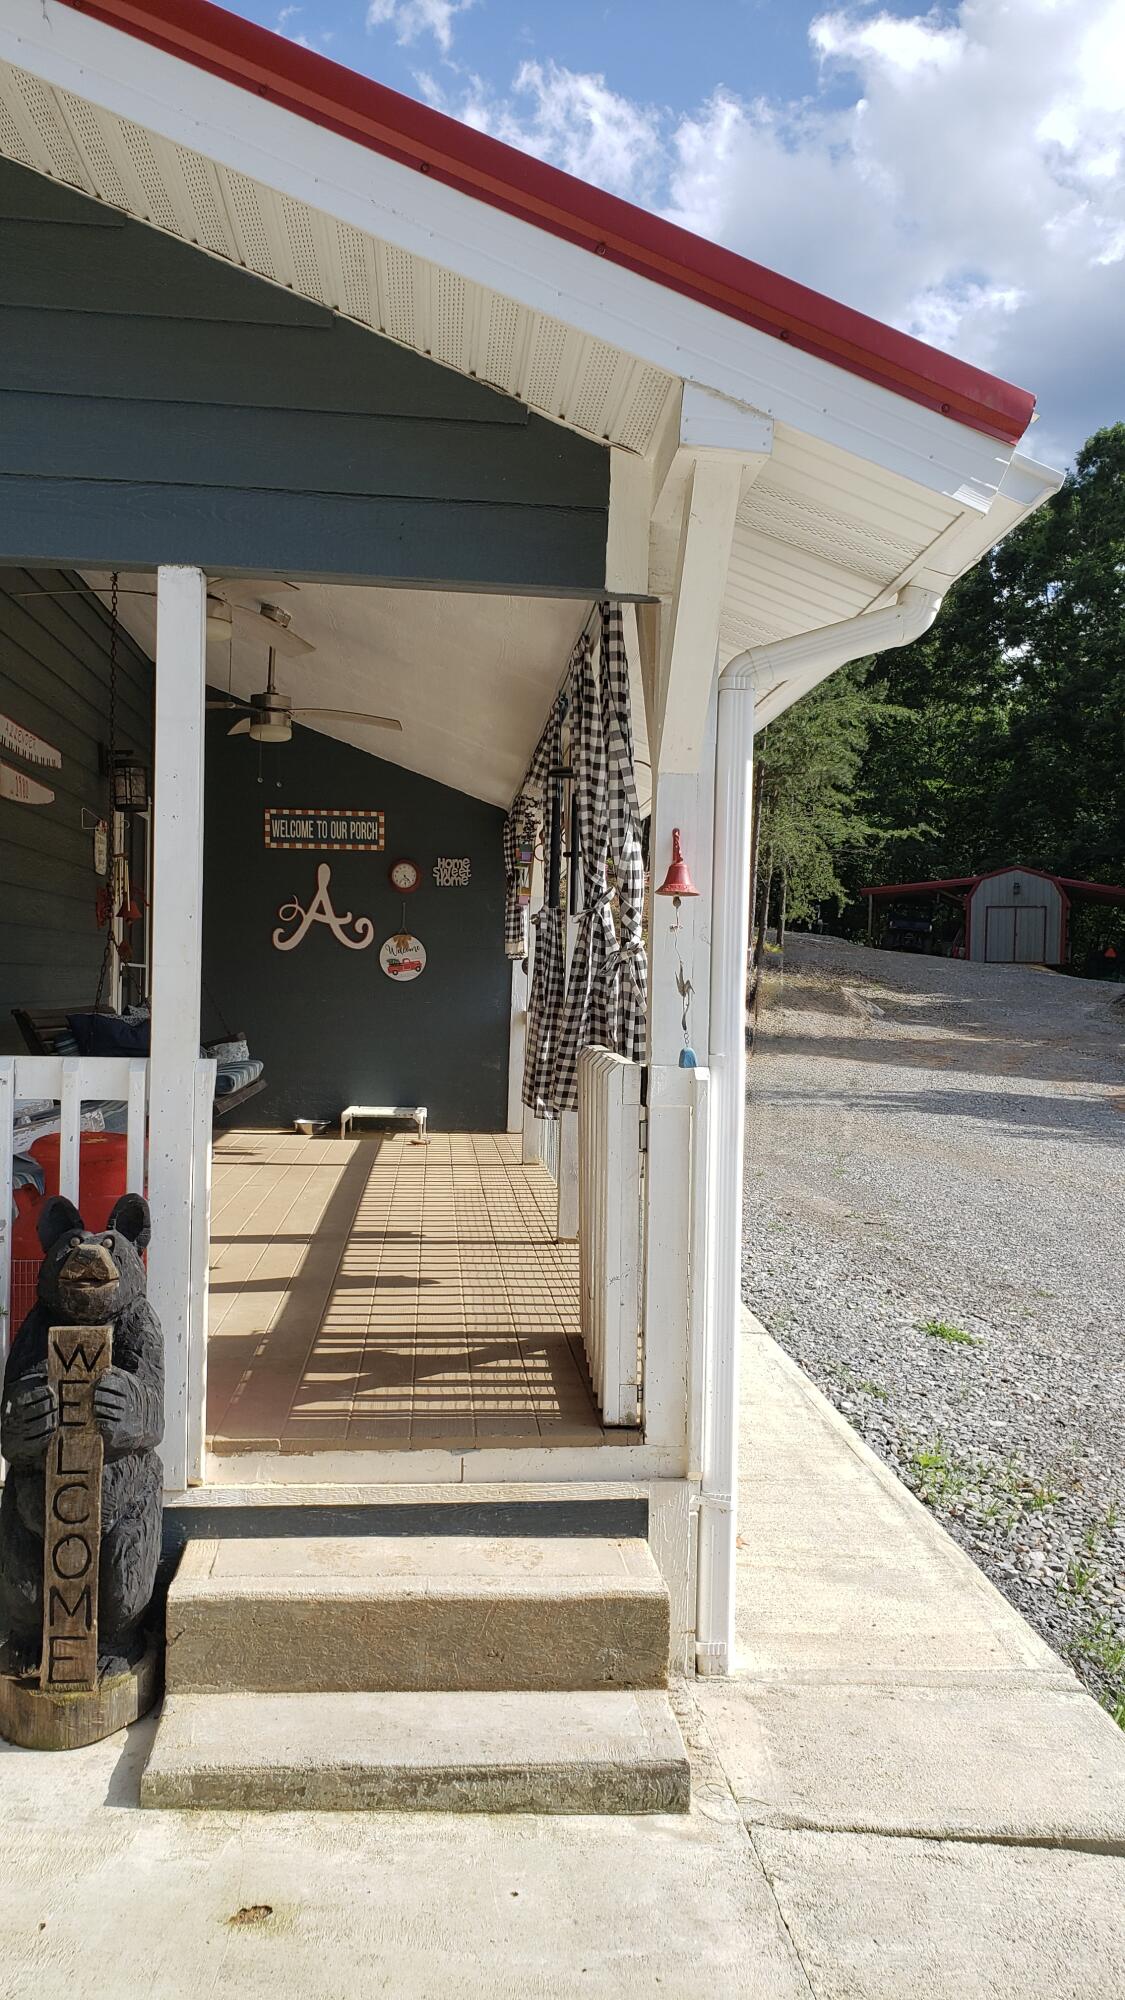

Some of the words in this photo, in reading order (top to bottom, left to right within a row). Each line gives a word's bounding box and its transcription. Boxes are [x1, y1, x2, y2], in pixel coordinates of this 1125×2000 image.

[271, 819, 314, 839] WELCOME
[316, 820, 328, 839] TO
[330, 820, 348, 840] OUR
[350, 820, 378, 841] PORCH
[437, 857, 471, 869] Home
[436, 876, 470, 887] Home
[272, 863, 375, 951] A
[384, 943, 421, 957] Welcome
[47, 1339, 106, 1685] WELCOME
